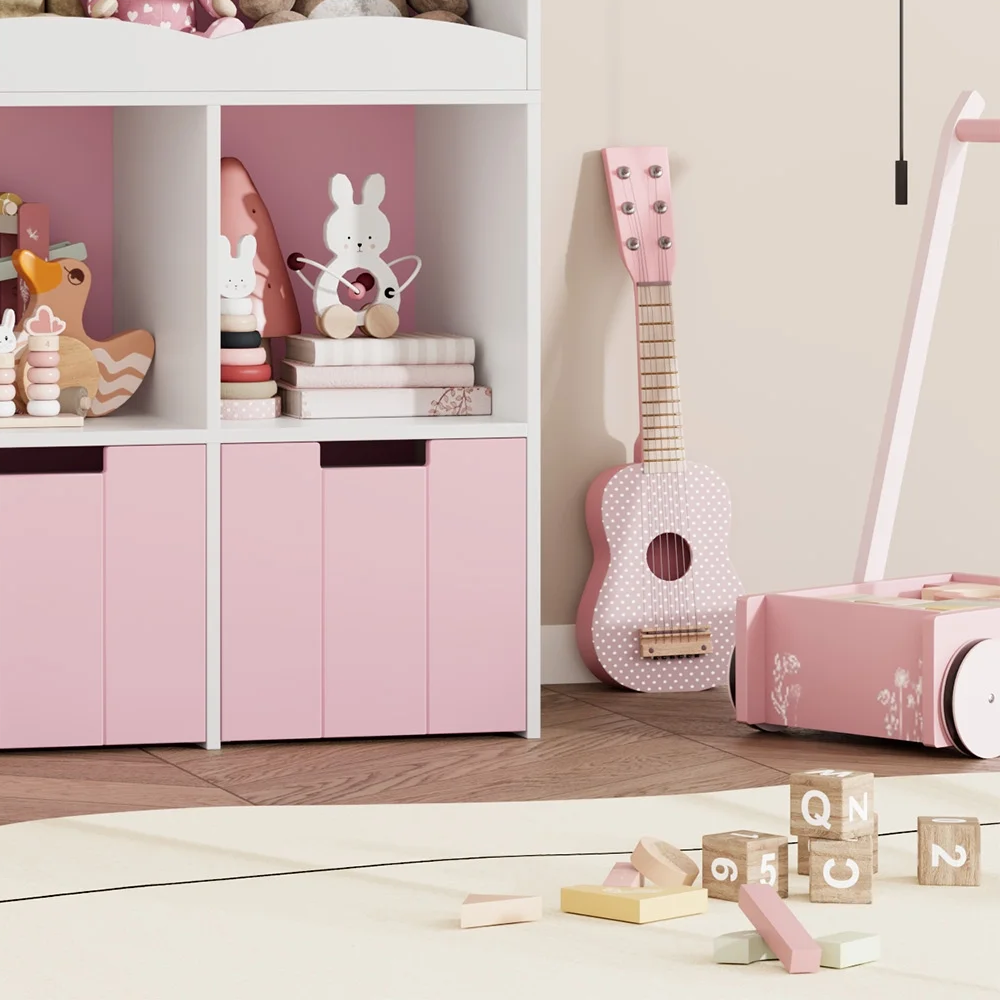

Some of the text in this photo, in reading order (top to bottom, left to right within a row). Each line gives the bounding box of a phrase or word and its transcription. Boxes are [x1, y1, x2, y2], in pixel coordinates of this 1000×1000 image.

[801, 789, 832, 830] Q
[848, 791, 868, 823] N
[760, 852, 777, 887] 5
[932, 843, 967, 868] 2
[823, 858, 860, 889] C
